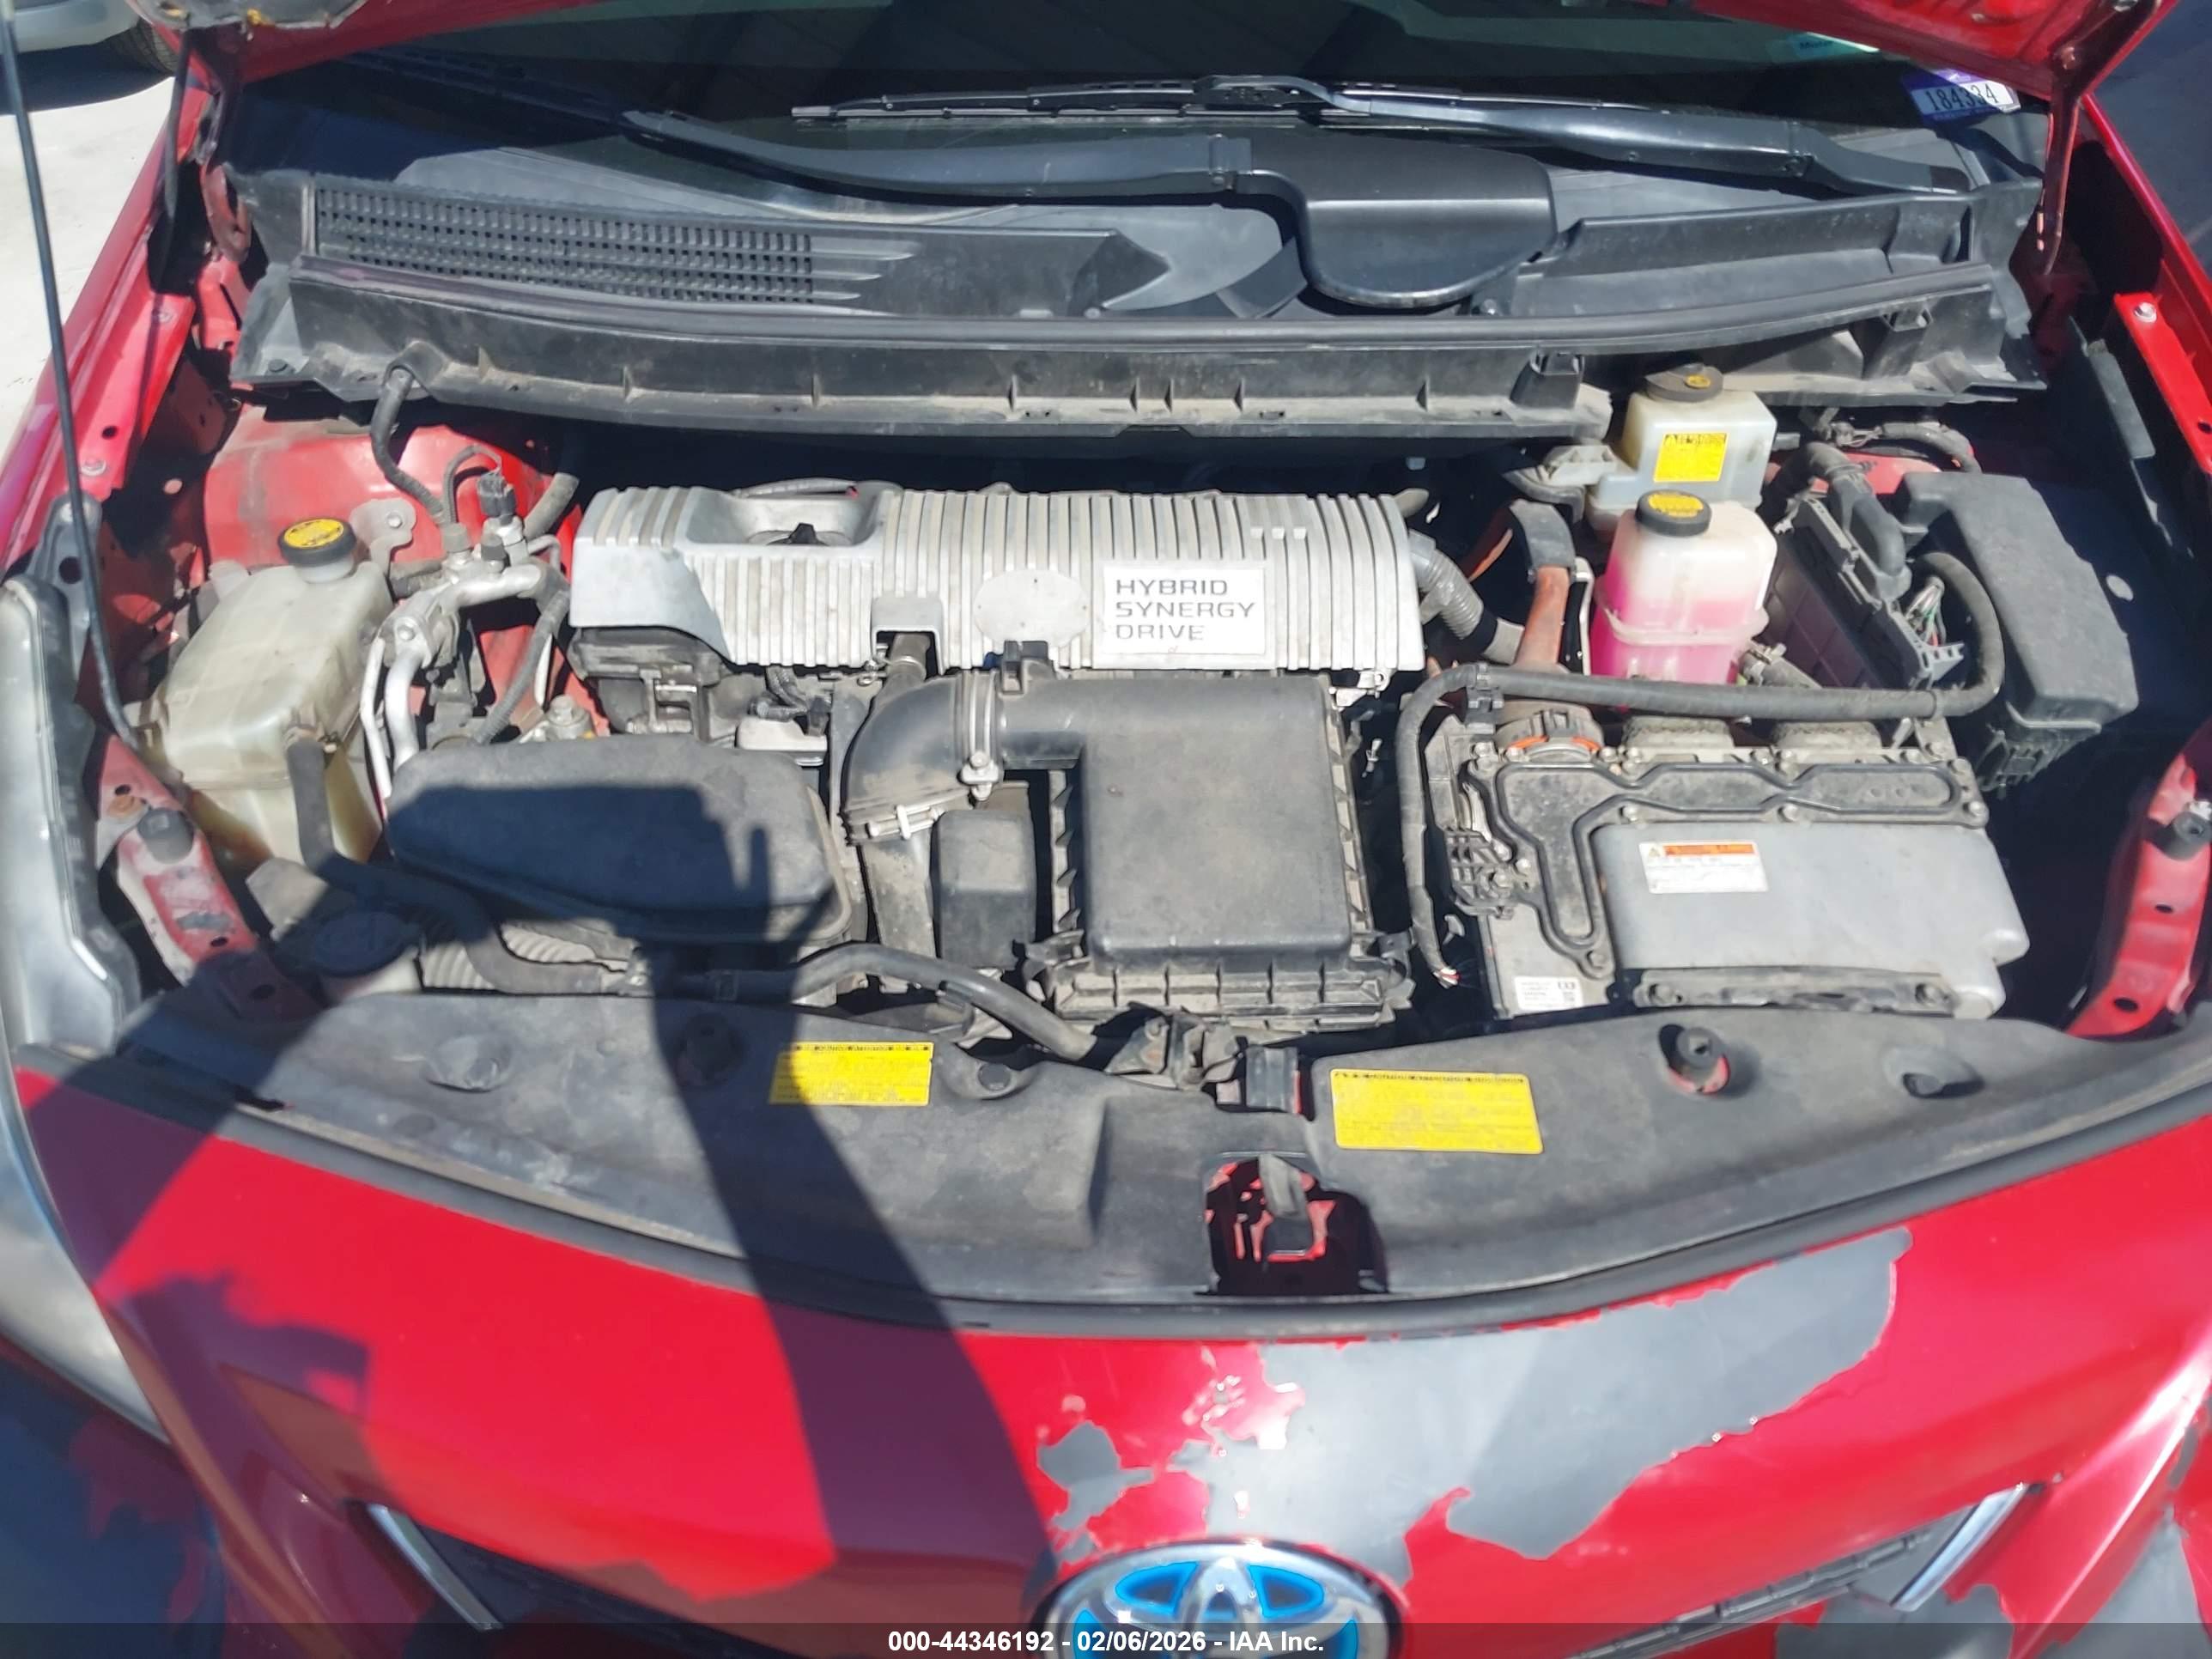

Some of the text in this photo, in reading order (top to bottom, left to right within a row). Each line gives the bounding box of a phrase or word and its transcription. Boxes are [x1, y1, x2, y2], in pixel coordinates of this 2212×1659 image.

[1925, 83, 1998, 111] 184334
[1115, 579, 1228, 596] HYBRID
[1115, 601, 1256, 618] SYNERGY
[1115, 623, 1205, 641] DRIVE
